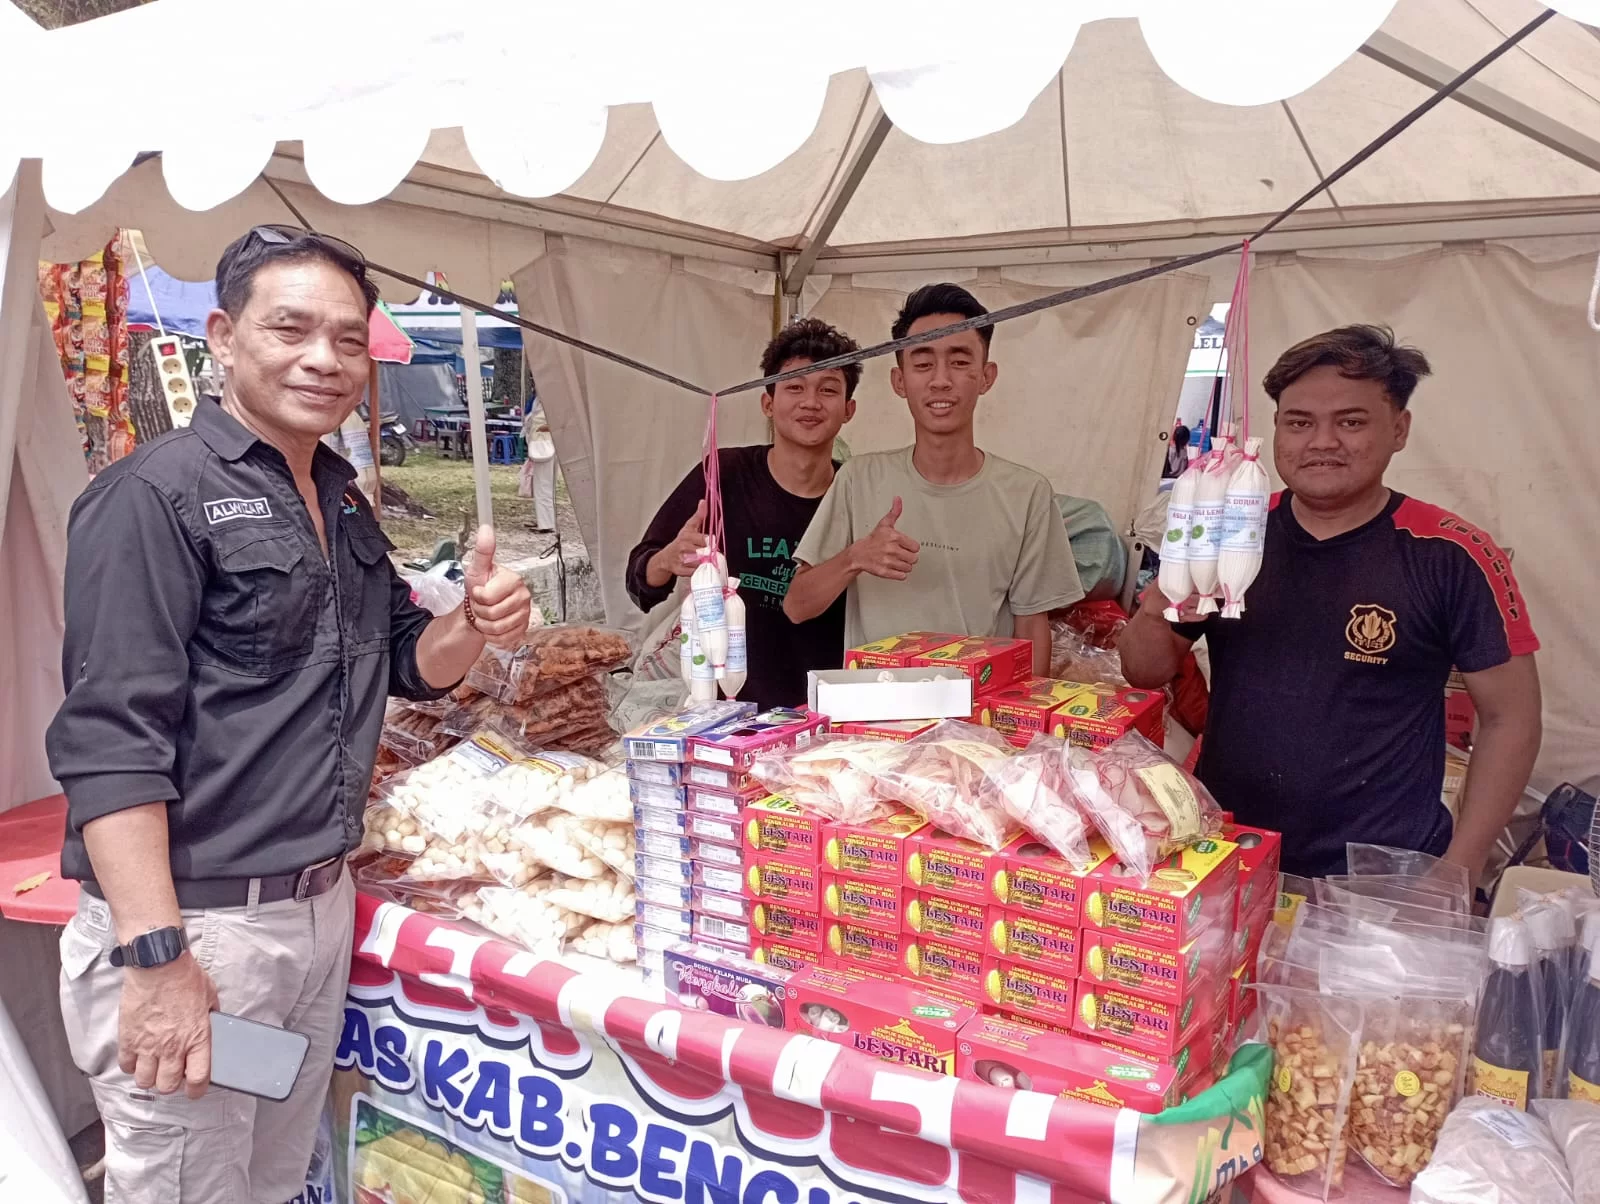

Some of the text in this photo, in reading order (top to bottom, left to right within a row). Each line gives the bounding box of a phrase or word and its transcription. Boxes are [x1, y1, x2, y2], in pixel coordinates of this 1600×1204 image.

[213, 502, 266, 519] ALWIZAR
[747, 537, 799, 560] LEA
[1344, 651, 1388, 664] SECURITY
[1069, 731, 1114, 744] LESTAR
[927, 861, 985, 881] LESTARI
[1014, 878, 1076, 902] LESTARI
[927, 908, 983, 930] LESTARI
[1109, 900, 1176, 924] LESTARI
[1012, 929, 1075, 953] LESTARI
[925, 953, 980, 975] LESTARI
[1110, 955, 1178, 980] LESTARI
[1007, 979, 1068, 1003] LESTARI
[1102, 1003, 1169, 1030] LESTARI
[872, 1031, 912, 1047] BENGKALIS
[854, 1032, 947, 1074] LESTARI
